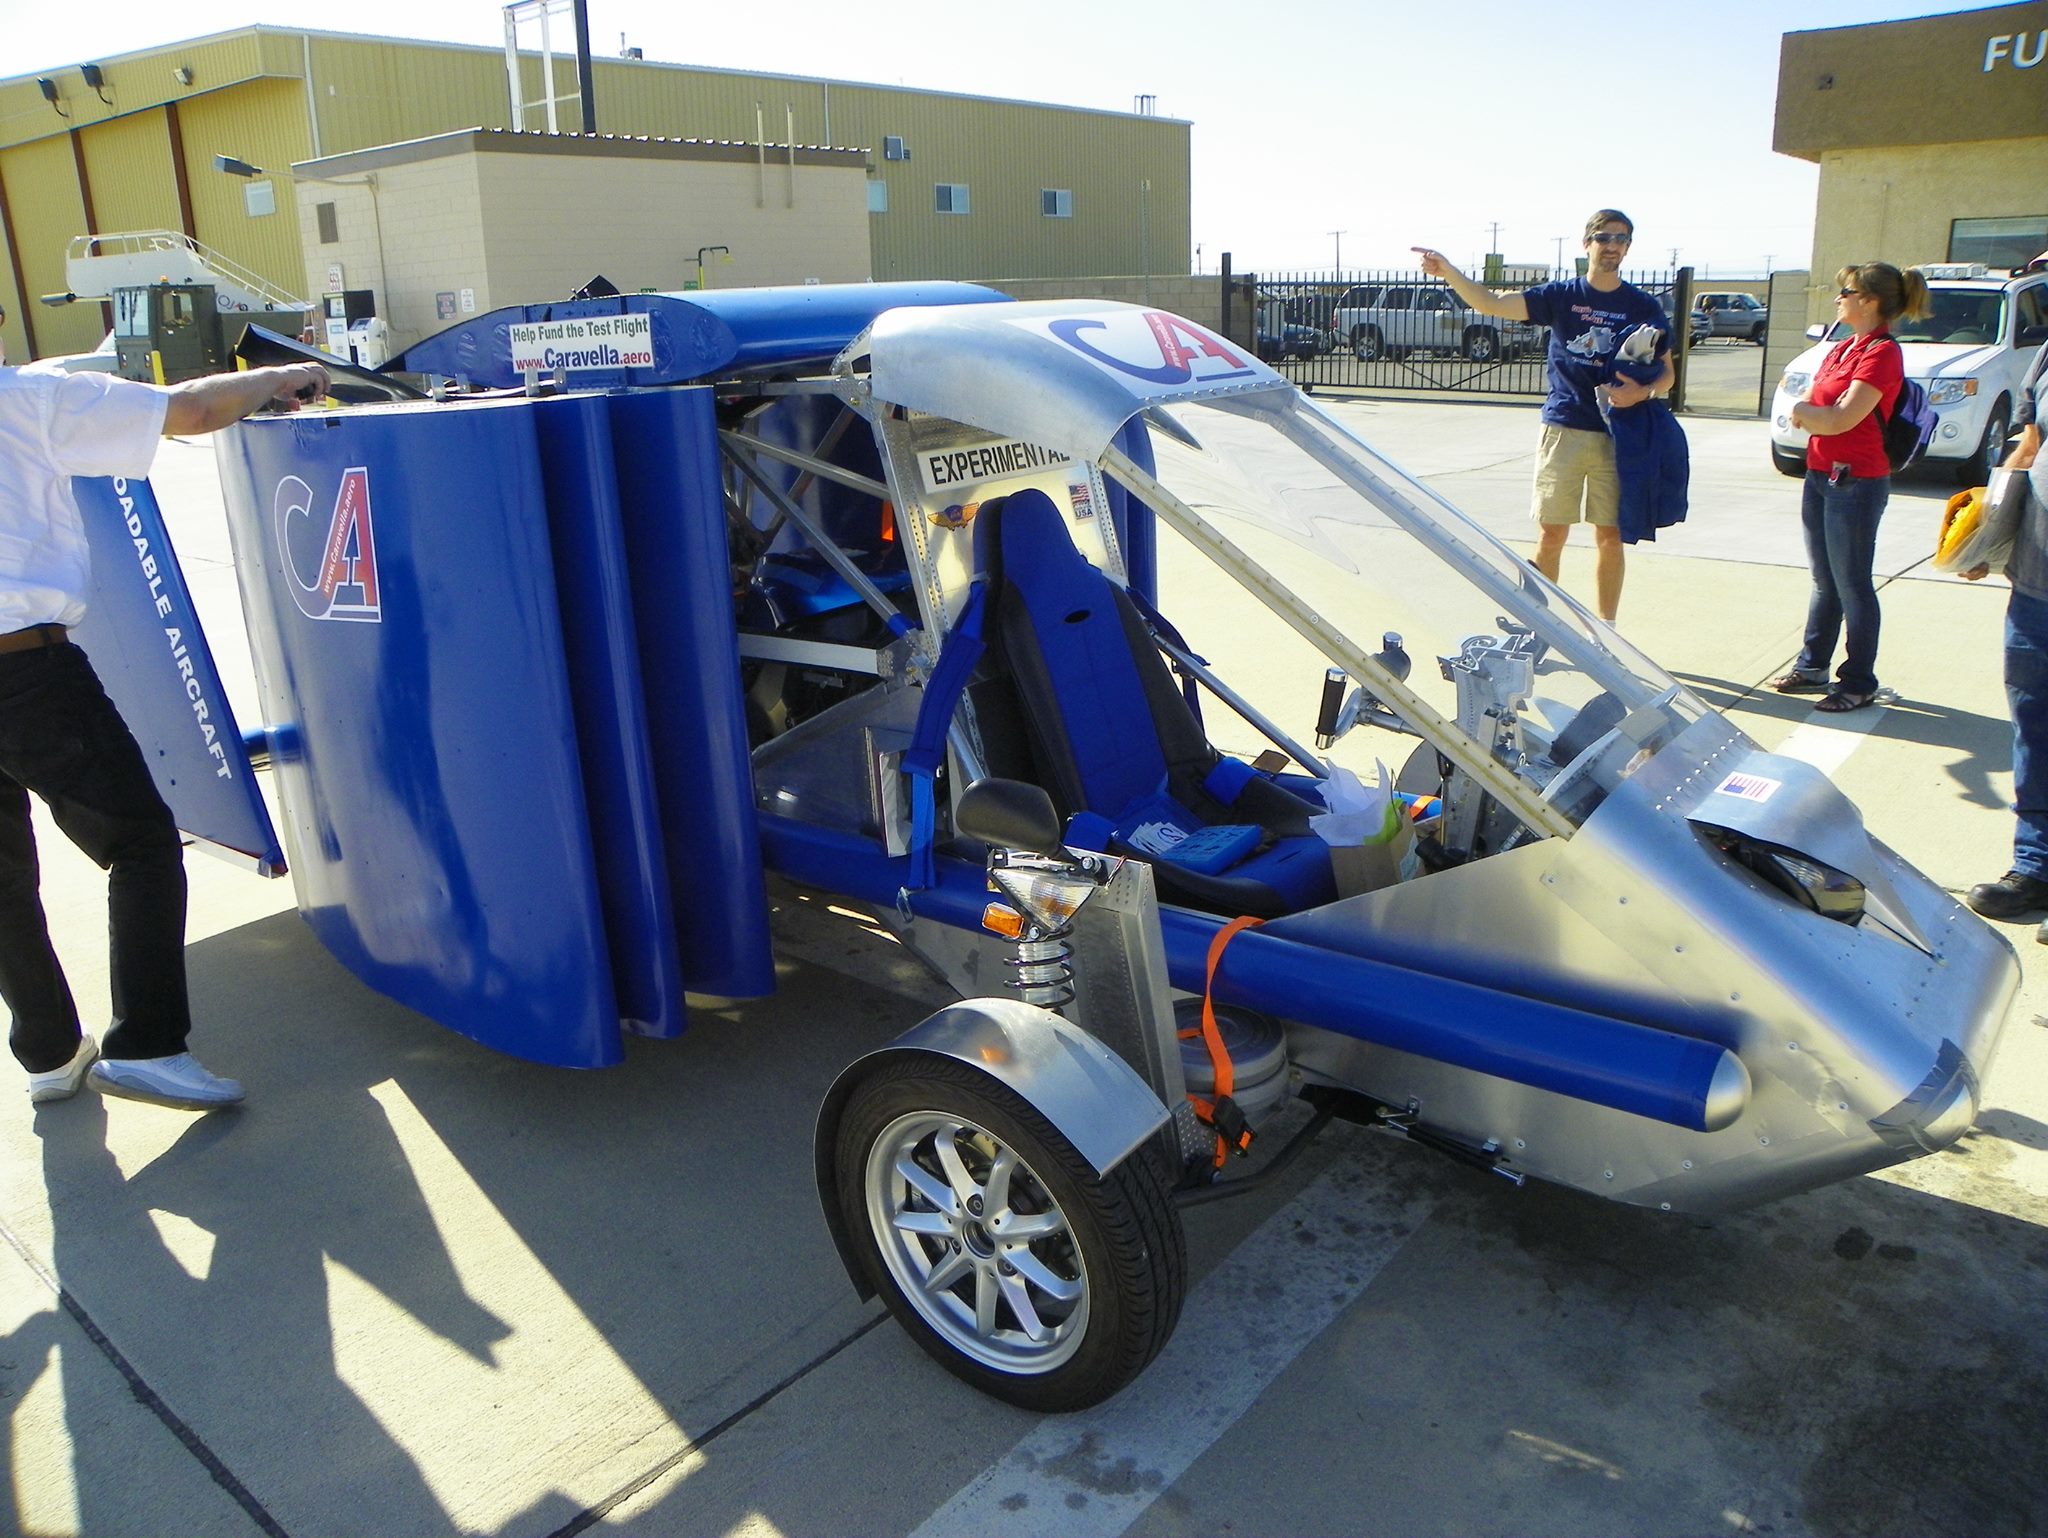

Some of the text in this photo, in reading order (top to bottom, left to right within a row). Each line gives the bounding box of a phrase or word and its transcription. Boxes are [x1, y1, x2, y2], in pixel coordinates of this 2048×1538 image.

[512, 317, 648, 344] Help Fund the Test Flight
[516, 344, 651, 370] www.Caravella.aero
[1075, 508, 1093, 518] USA
[165, 628, 232, 780] AIRCRAFT
